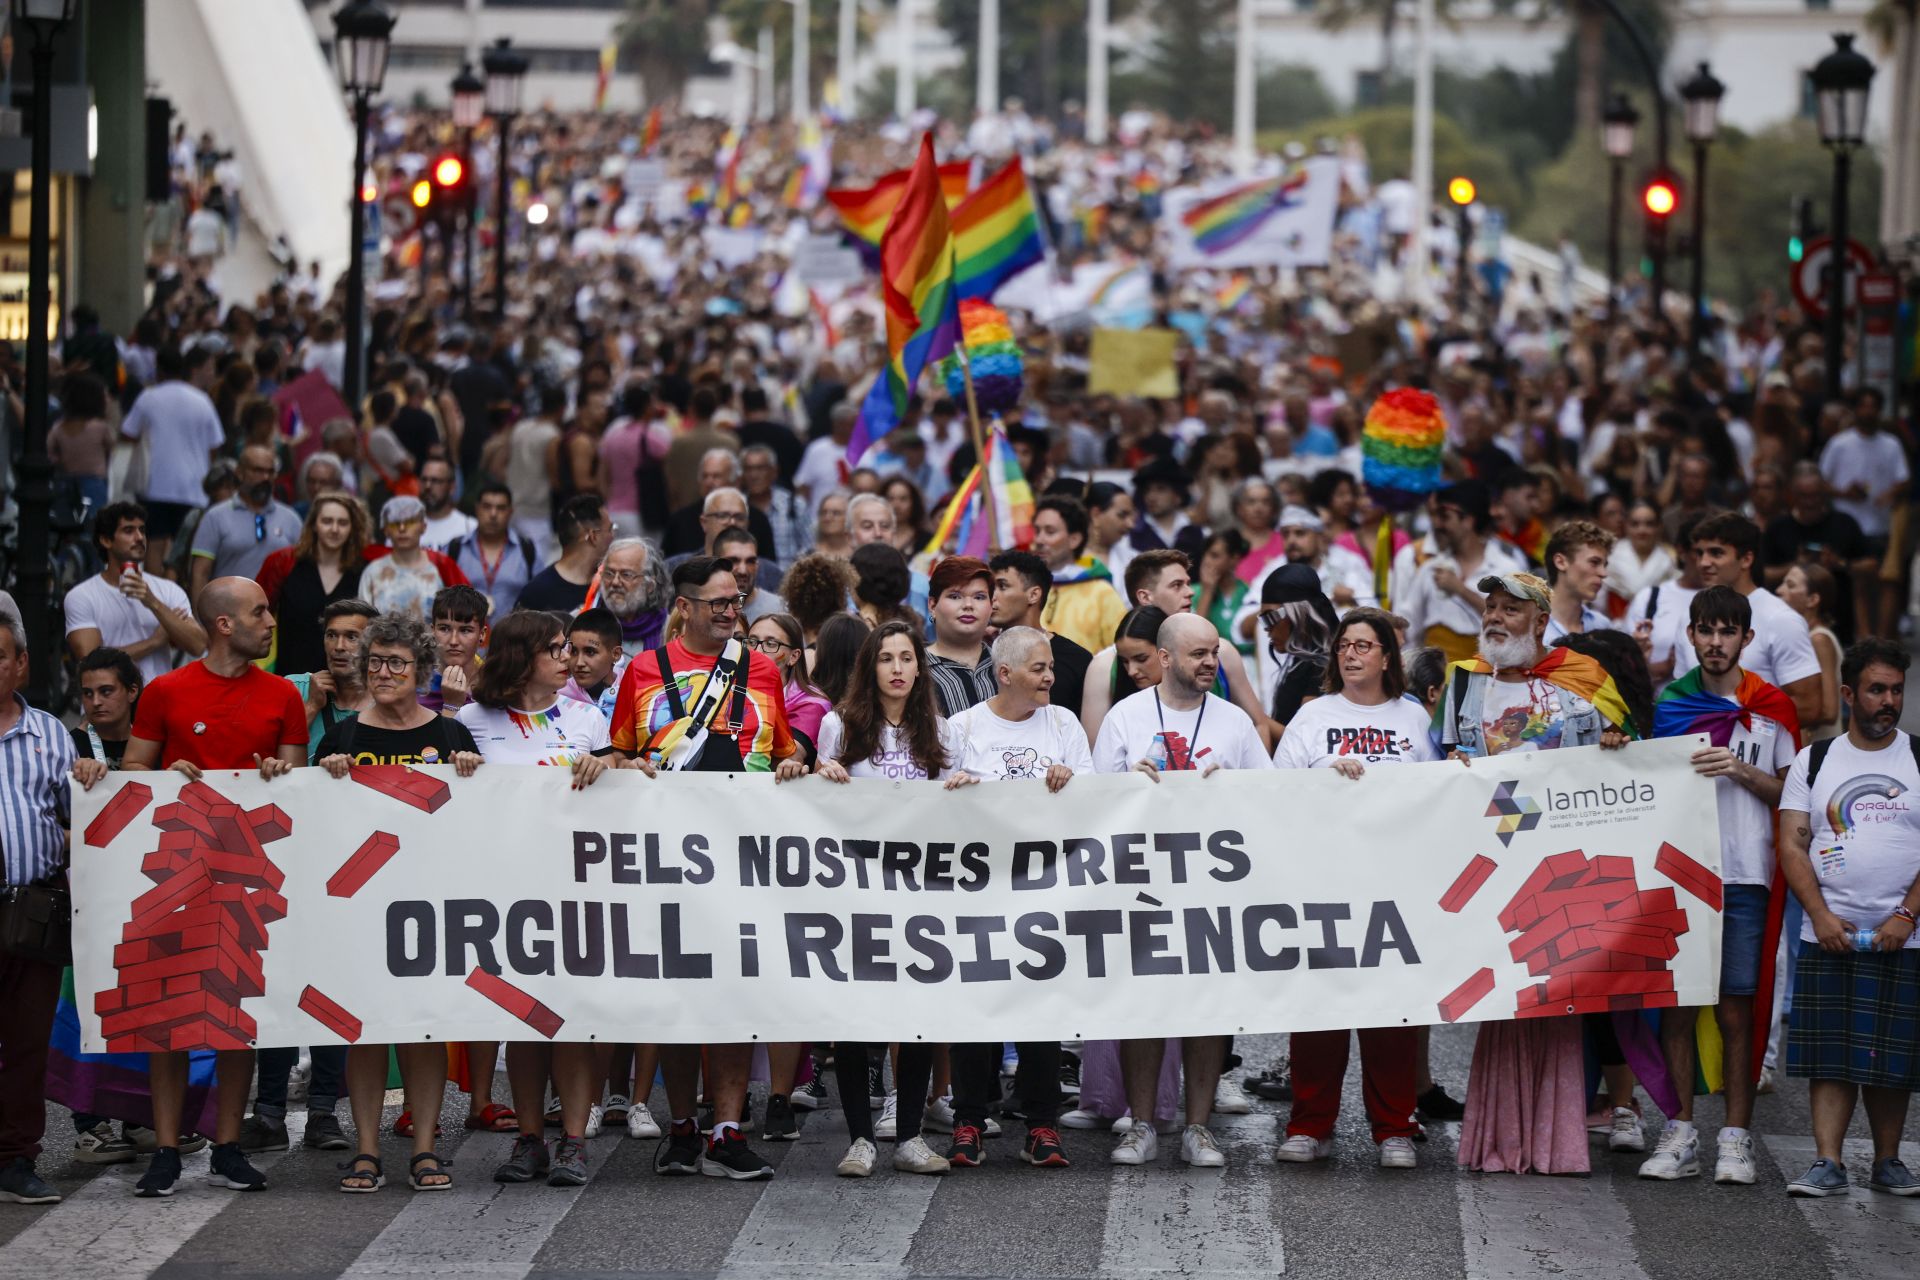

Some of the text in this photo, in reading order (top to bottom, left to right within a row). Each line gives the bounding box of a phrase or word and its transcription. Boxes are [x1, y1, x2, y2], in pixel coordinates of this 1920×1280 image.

[1327, 728, 1400, 756] PRIDE
[1546, 779, 1655, 812] lambda
[1625, 804, 1656, 813] diversitat
[1855, 801, 1911, 811] ORGULL
[1614, 814, 1640, 823] familiar
[572, 829, 1252, 892] PELS NOSTRES DRETS
[386, 891, 1422, 984] ORGULL i RESISTÈNCIA
